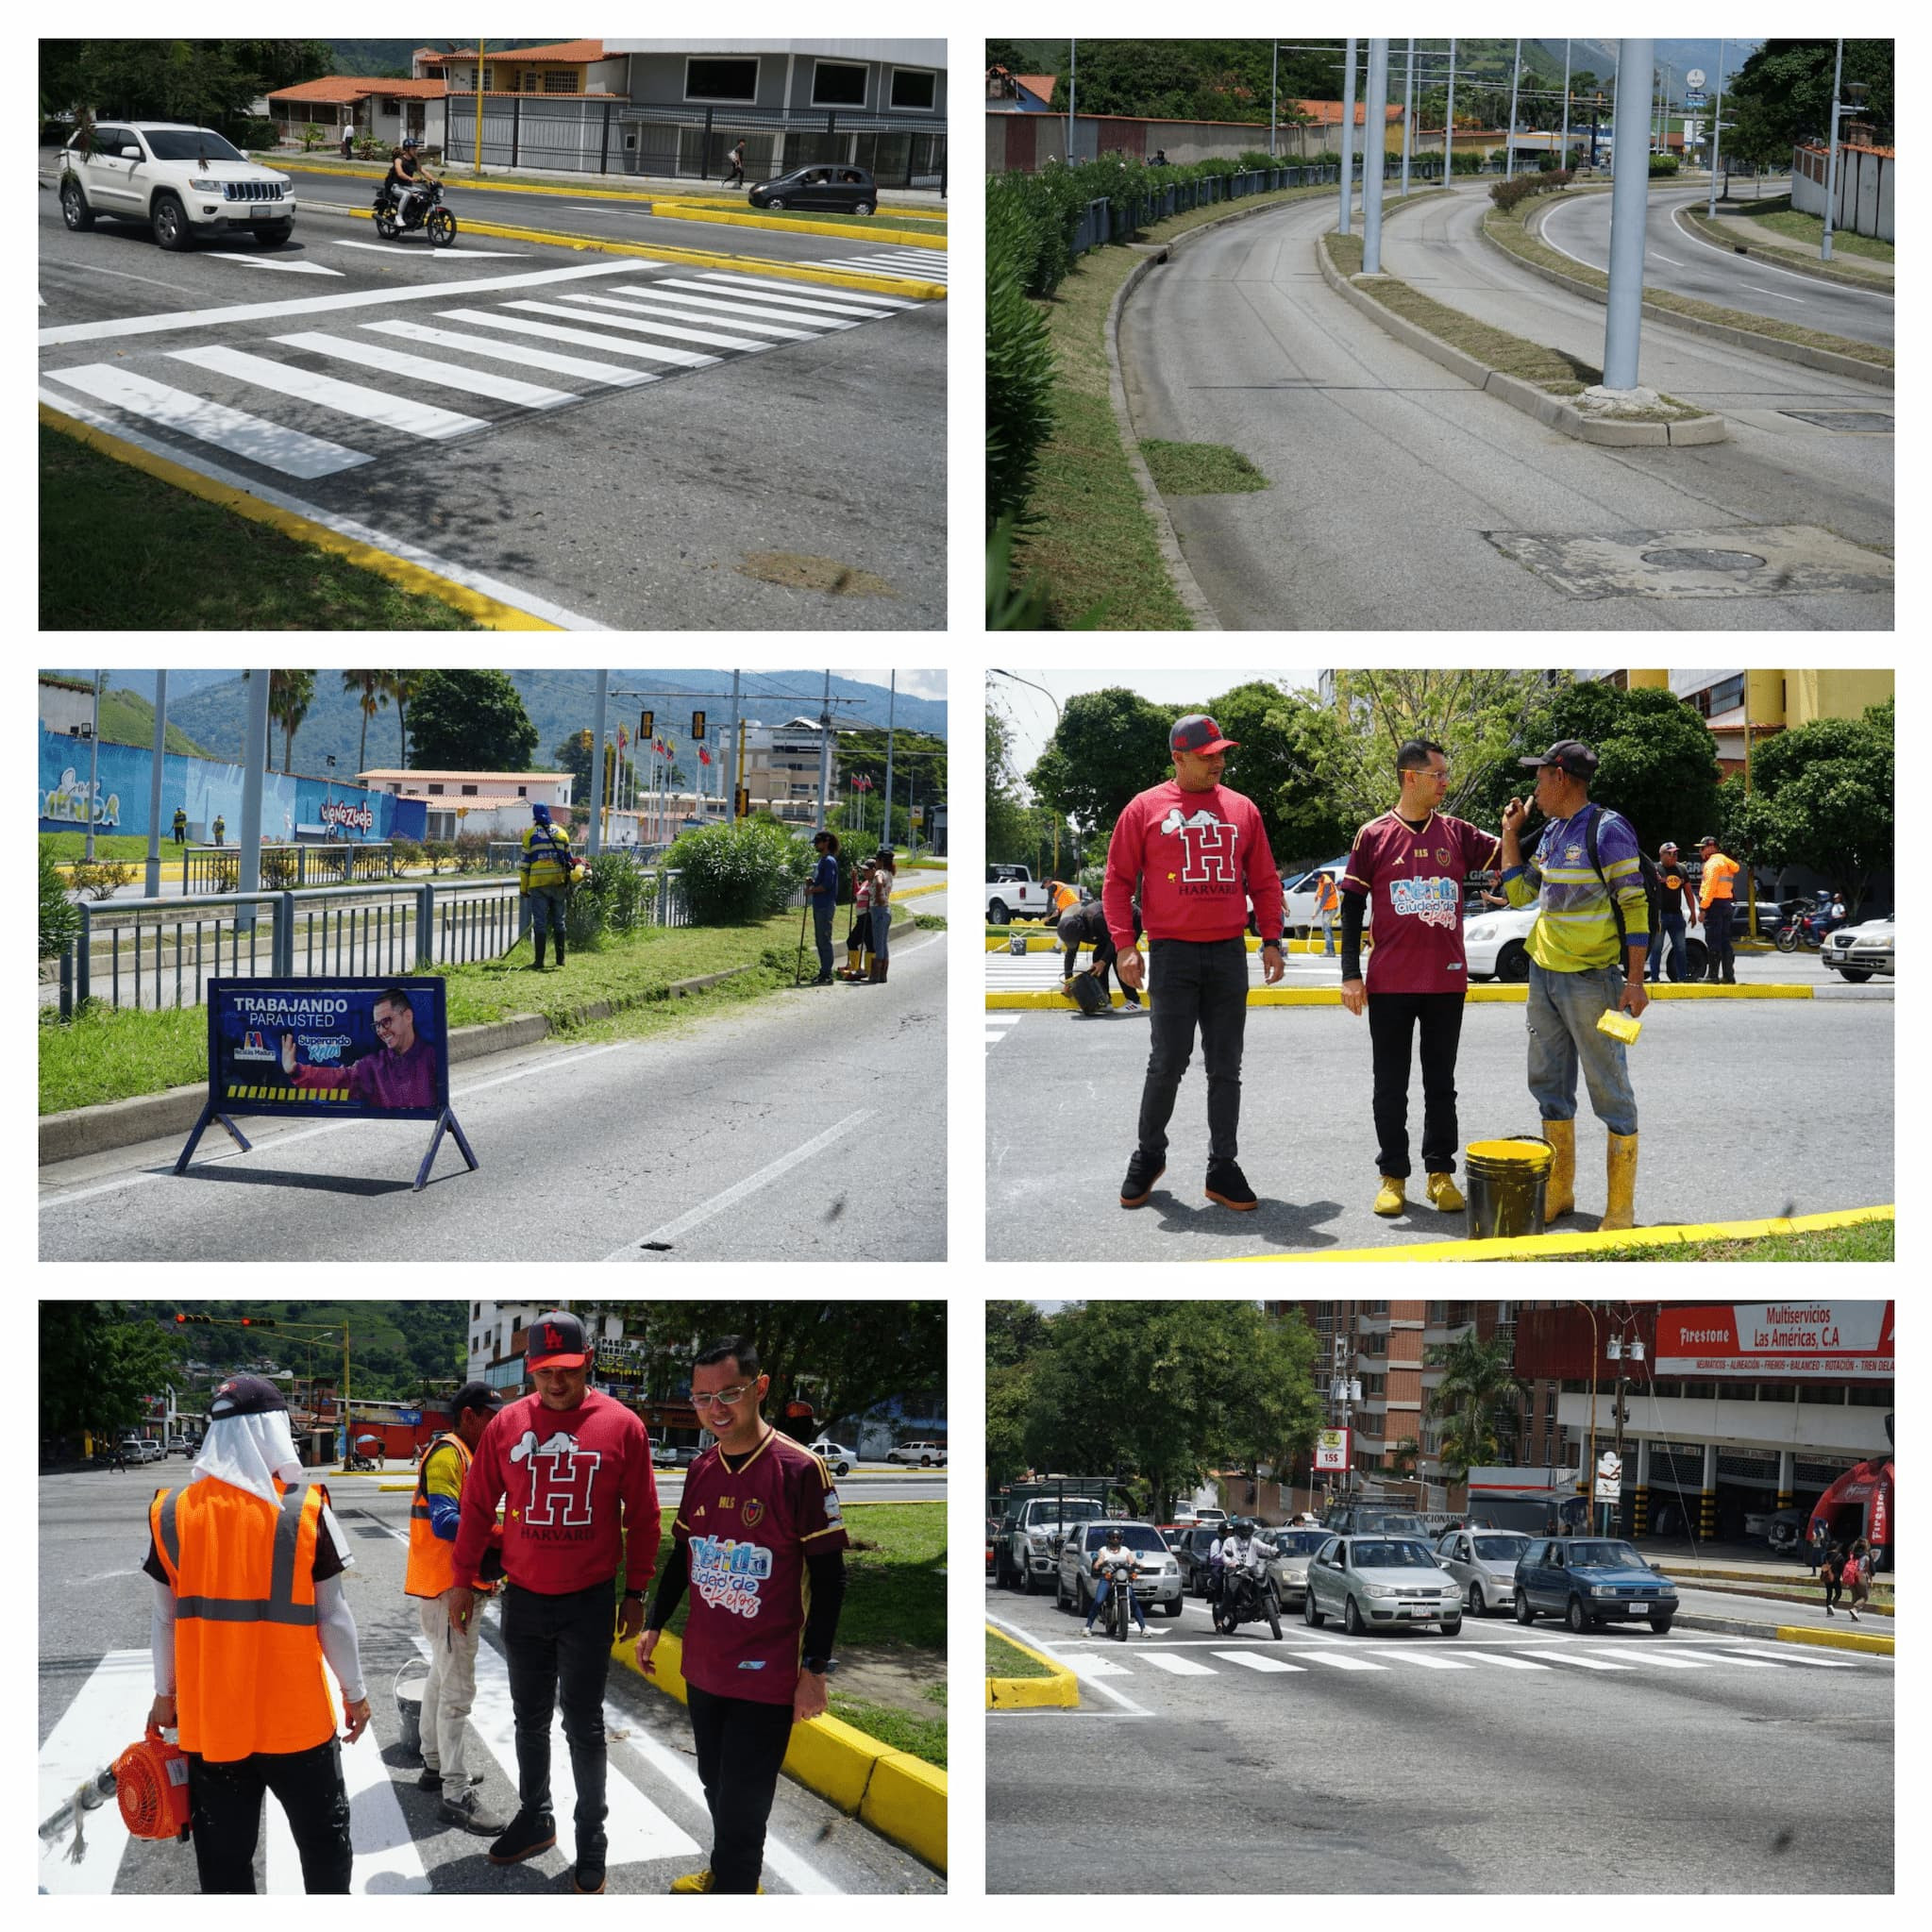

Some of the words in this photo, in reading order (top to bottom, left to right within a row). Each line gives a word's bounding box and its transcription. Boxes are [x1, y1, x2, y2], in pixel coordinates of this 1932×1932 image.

[1179, 883, 1237, 896] HARVARD
[234, 998, 348, 1013] TRABAJANDO
[249, 1013, 284, 1026] PARA
[287, 1015, 335, 1027] USTED
[298, 1034, 351, 1046] Superando
[1767, 1304, 1831, 1324] Multiservicios
[544, 1323, 564, 1350] LA
[1680, 1327, 1730, 1347] Firestone
[1755, 1329, 1769, 1347] Las
[1771, 1326, 1819, 1350] Américas,
[1823, 1326, 1840, 1347] C.A
[1861, 1360, 1876, 1371] TREN
[1324, 1453, 1339, 1463] 15$
[1872, 1482, 1888, 1540] Firestone
[520, 1527, 595, 1541] HARVARD
[731, 1576, 756, 1592] de
